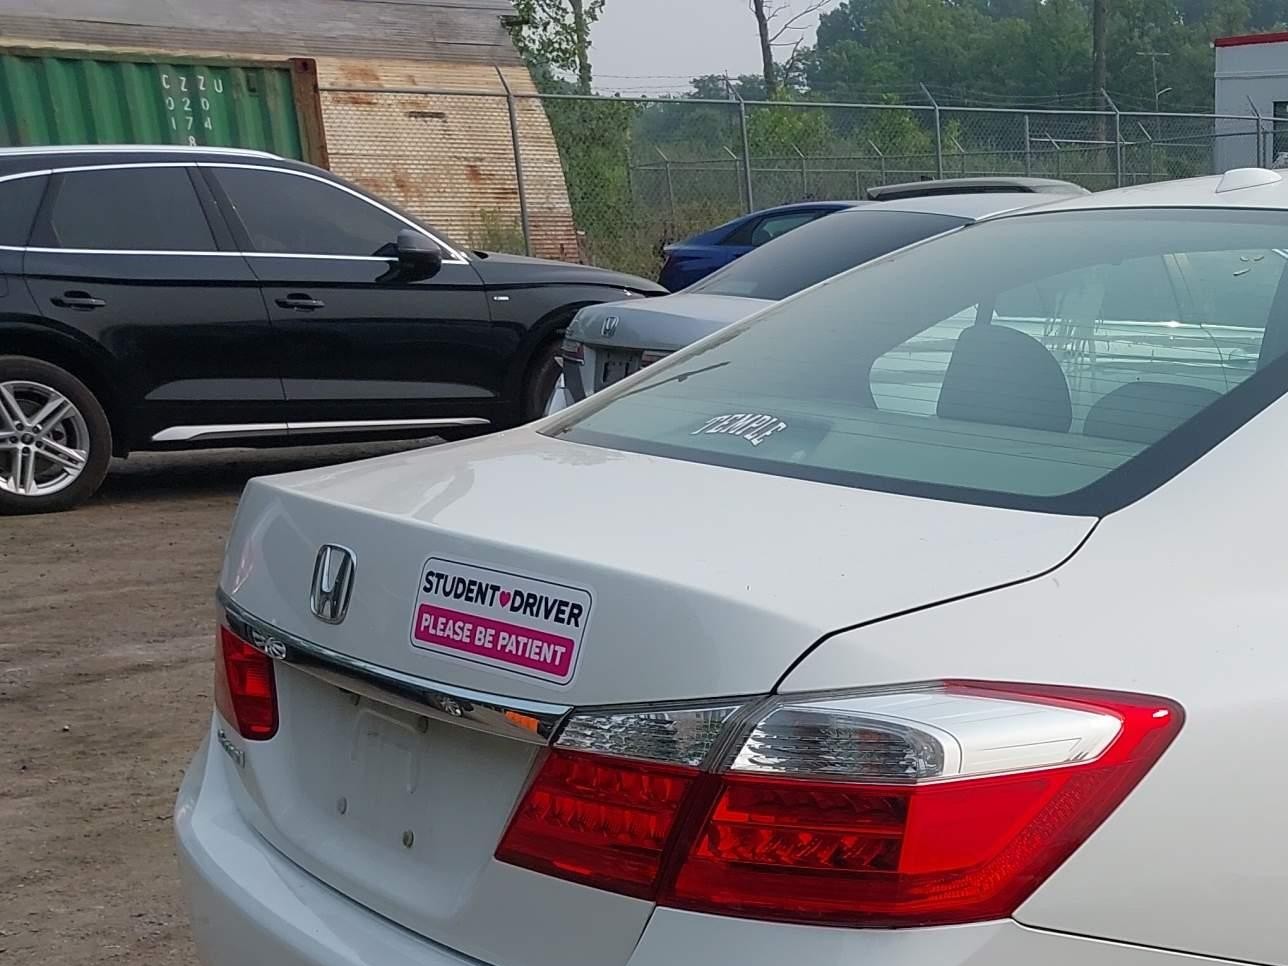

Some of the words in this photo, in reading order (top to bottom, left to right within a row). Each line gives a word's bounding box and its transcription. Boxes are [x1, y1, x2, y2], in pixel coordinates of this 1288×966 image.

[166, 97, 210, 110] 020
[171, 116, 212, 130] 174
[690, 413, 787, 446] TEMPLE
[423, 570, 500, 607] STUDENT
[509, 590, 583, 627] DRIVER
[420, 613, 473, 643] PLEASE
[474, 624, 496, 649] BE
[497, 632, 566, 666] PATIENT
